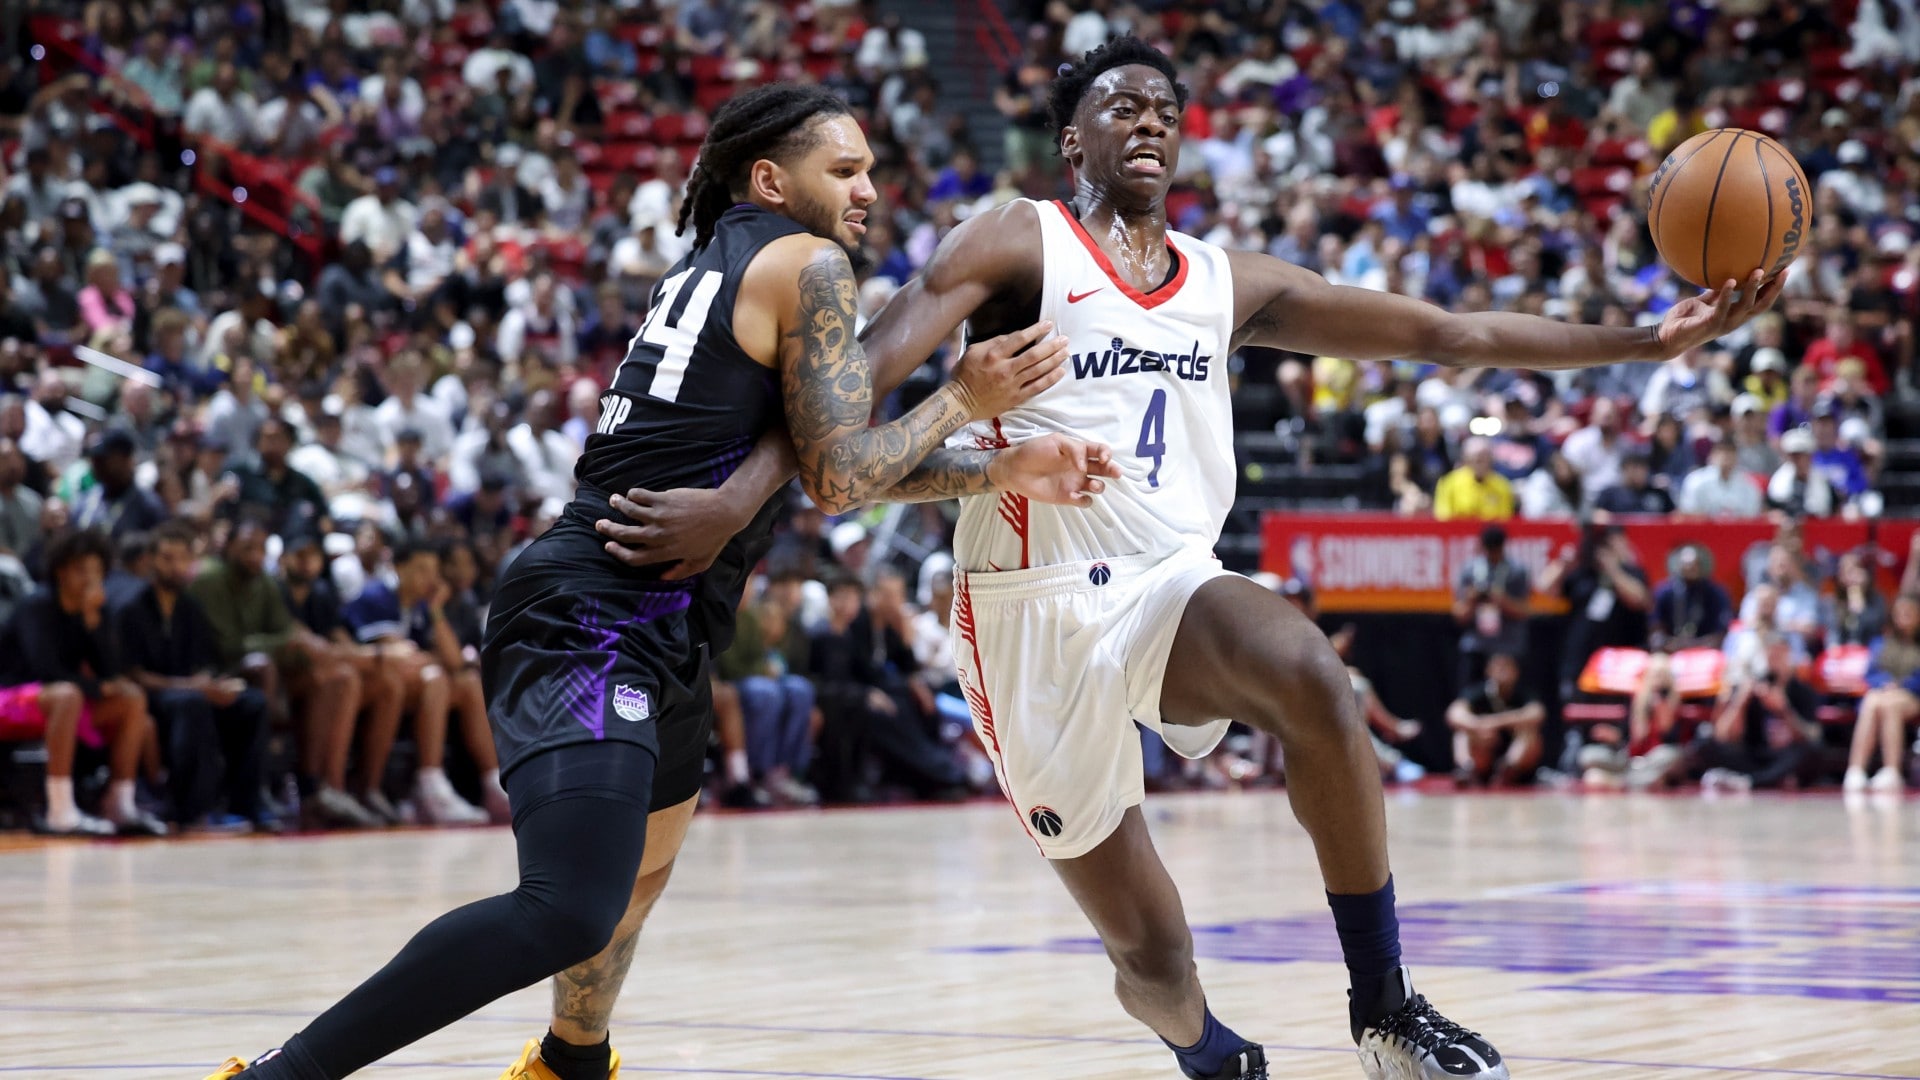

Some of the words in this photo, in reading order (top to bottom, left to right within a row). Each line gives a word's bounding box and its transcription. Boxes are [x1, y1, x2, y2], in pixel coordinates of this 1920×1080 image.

[610, 267, 723, 403] 4
[1135, 389, 1166, 488] 4
[1318, 535, 1444, 590] SUMMER
